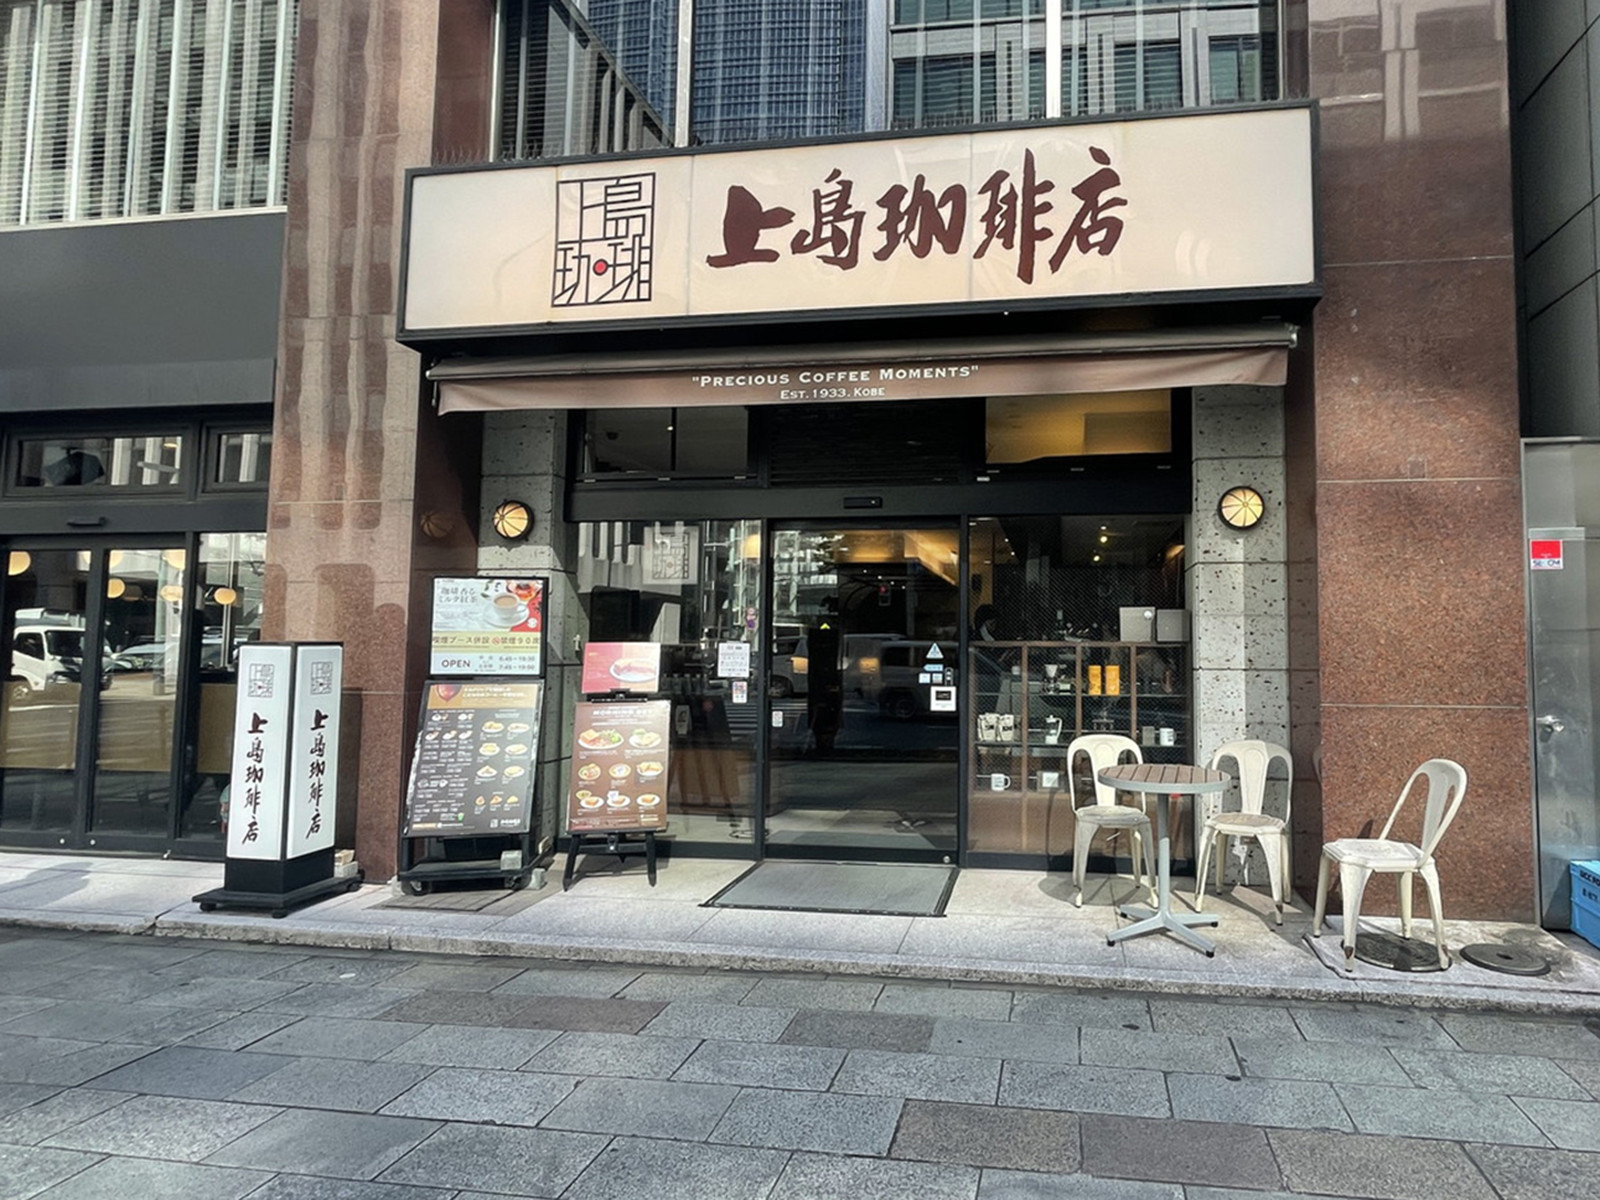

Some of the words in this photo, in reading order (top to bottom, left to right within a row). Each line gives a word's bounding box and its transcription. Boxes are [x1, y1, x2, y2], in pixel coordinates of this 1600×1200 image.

[706, 147, 1127, 285] 上島珈琲店
[799, 370, 871, 384] COFFEE
[854, 387, 886, 397] KOBE
[441, 659, 471, 668] OPEN
[242, 711, 268, 844] 上島珈琲店
[306, 708, 329, 839] 上島珈琲店
